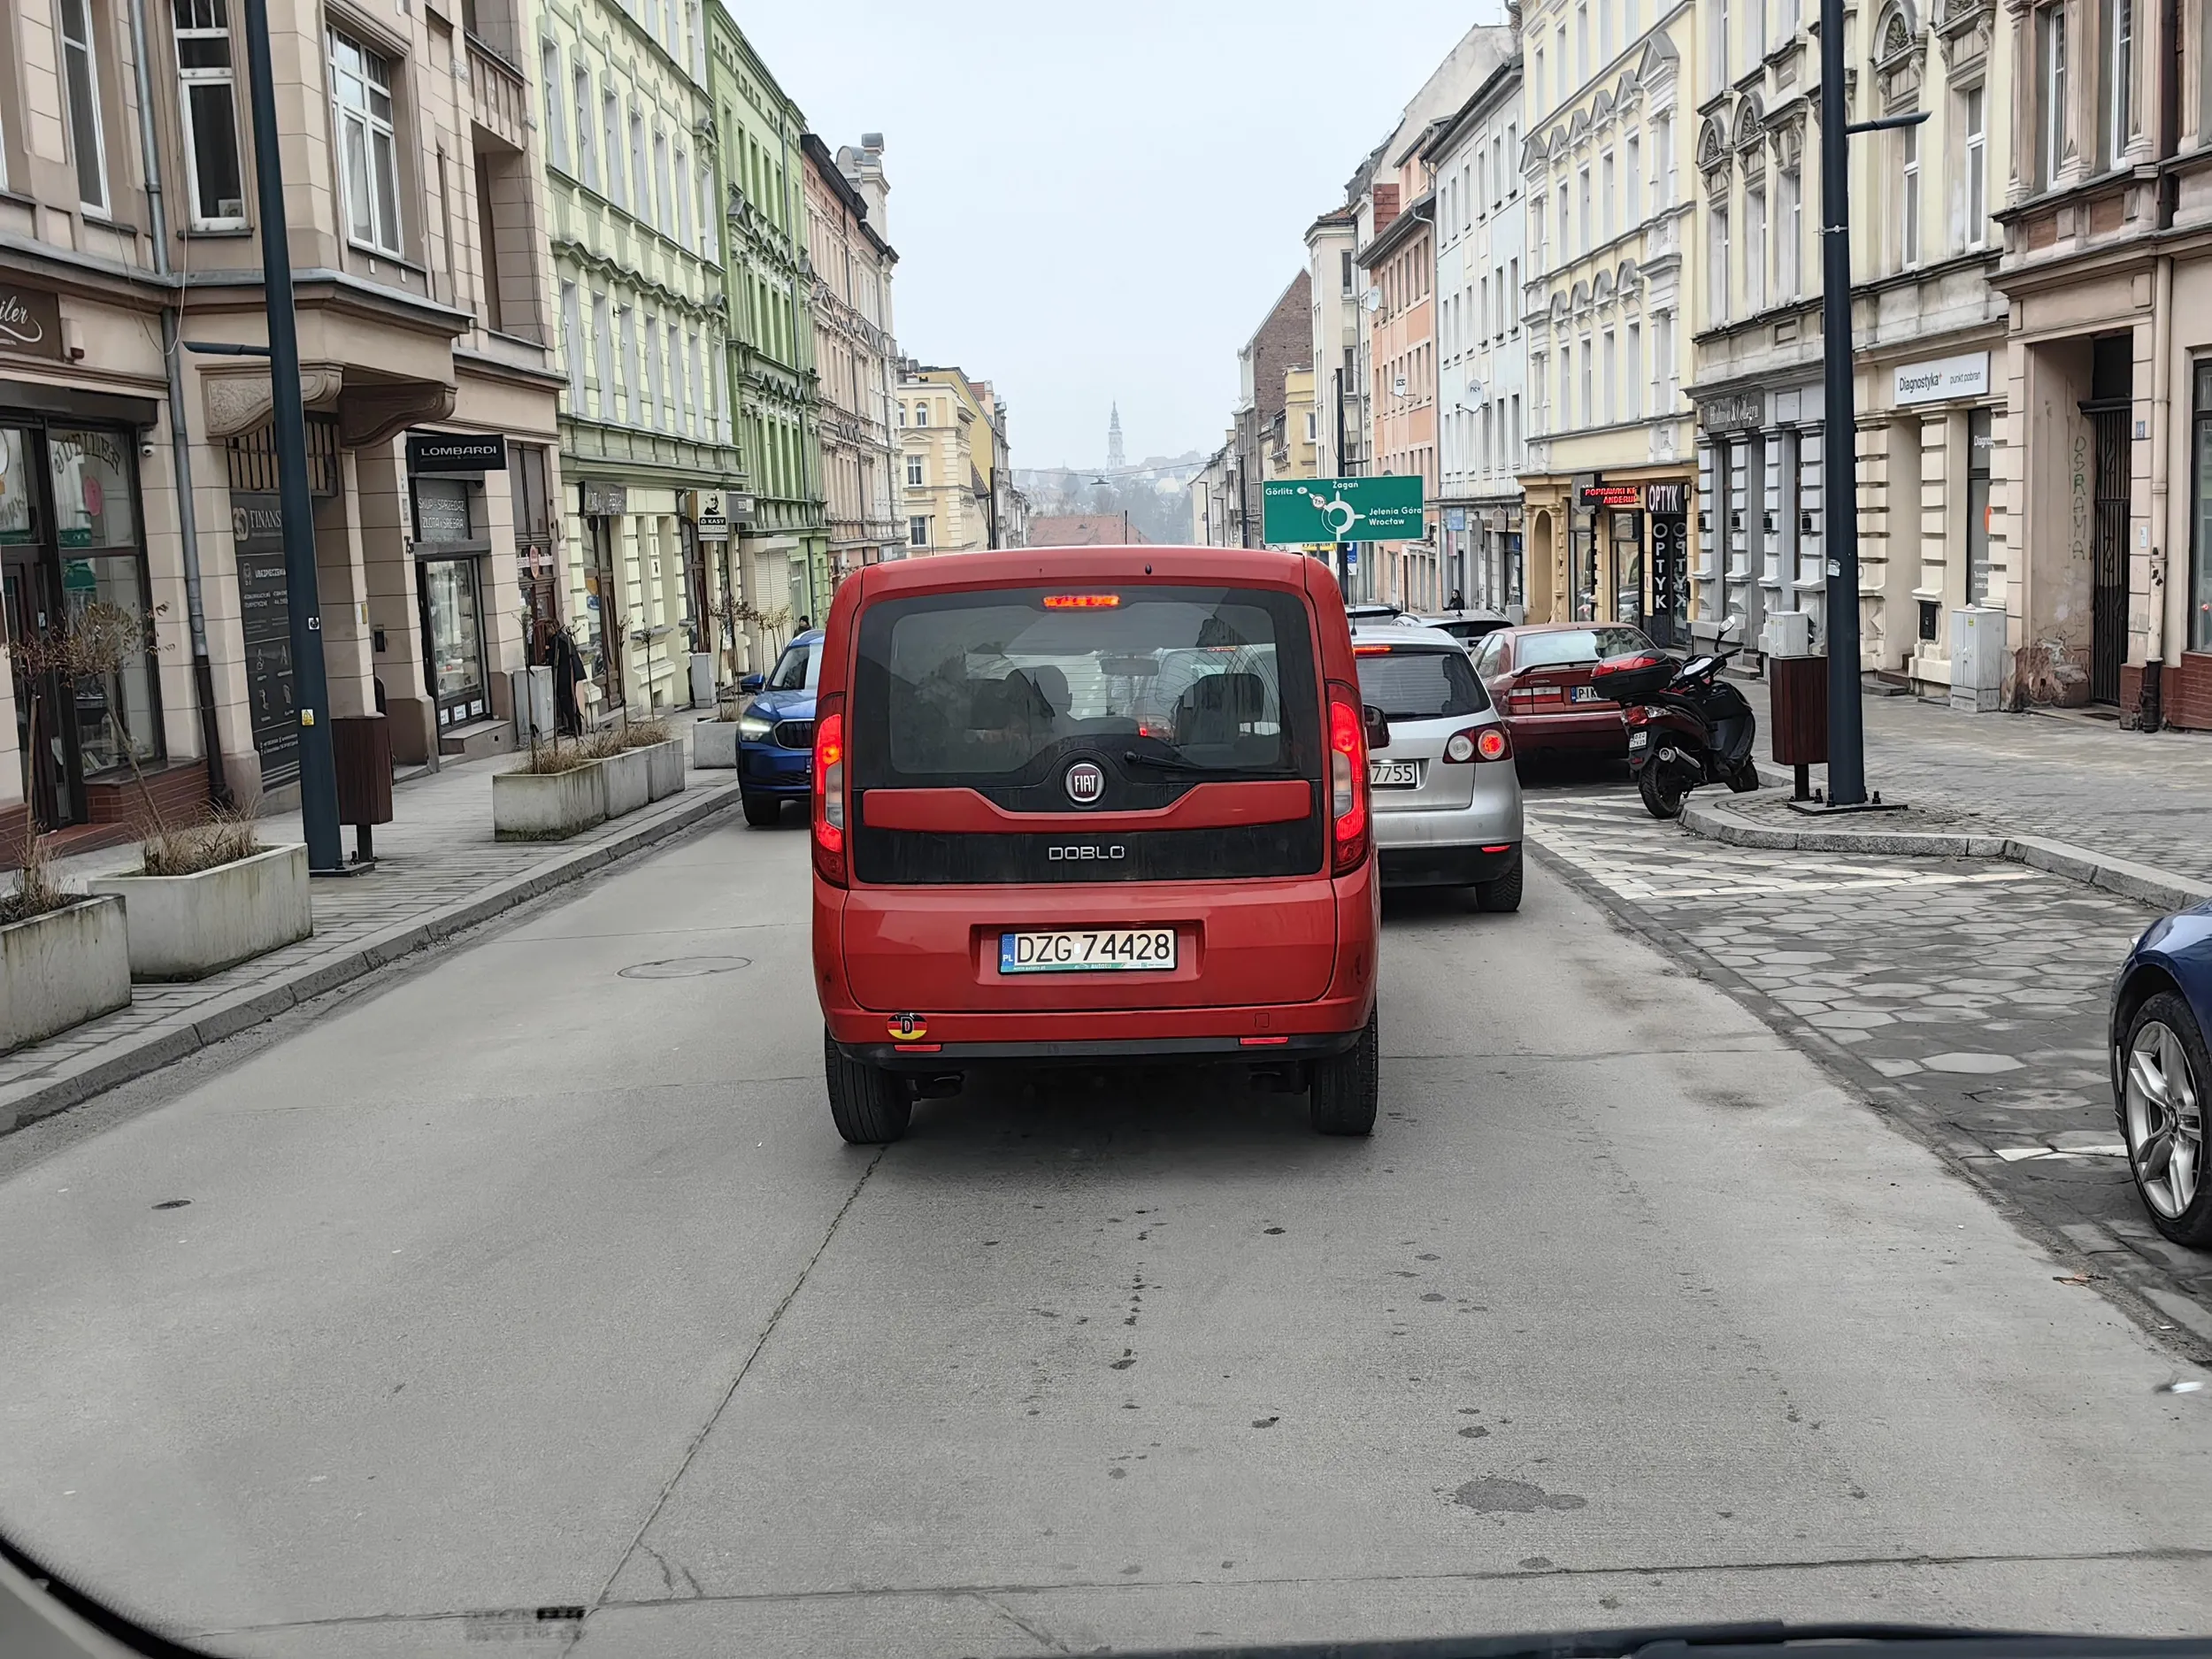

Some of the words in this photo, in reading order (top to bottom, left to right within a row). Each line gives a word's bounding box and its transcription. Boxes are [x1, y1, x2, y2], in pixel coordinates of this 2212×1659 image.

[421, 445, 497, 457] LOMBARDI
[1265, 488, 1294, 496] Görlitz
[1333, 480, 1359, 490] Żagań
[1648, 485, 1678, 511] OPTYK
[1369, 507, 1399, 517] Jelenia
[1401, 505, 1423, 516] Góra
[1368, 518, 1405, 527] Wrocław
[1653, 523, 1668, 609] OPTYK
[1372, 764, 1413, 782] 7755
[1074, 774, 1096, 793] FIAT
[1048, 845, 1125, 861] DOBLO
[1018, 935, 1071, 964] DZG
[1082, 933, 1171, 961] 74428
[1002, 954, 1014, 963] PL
[901, 1017, 914, 1034] D
